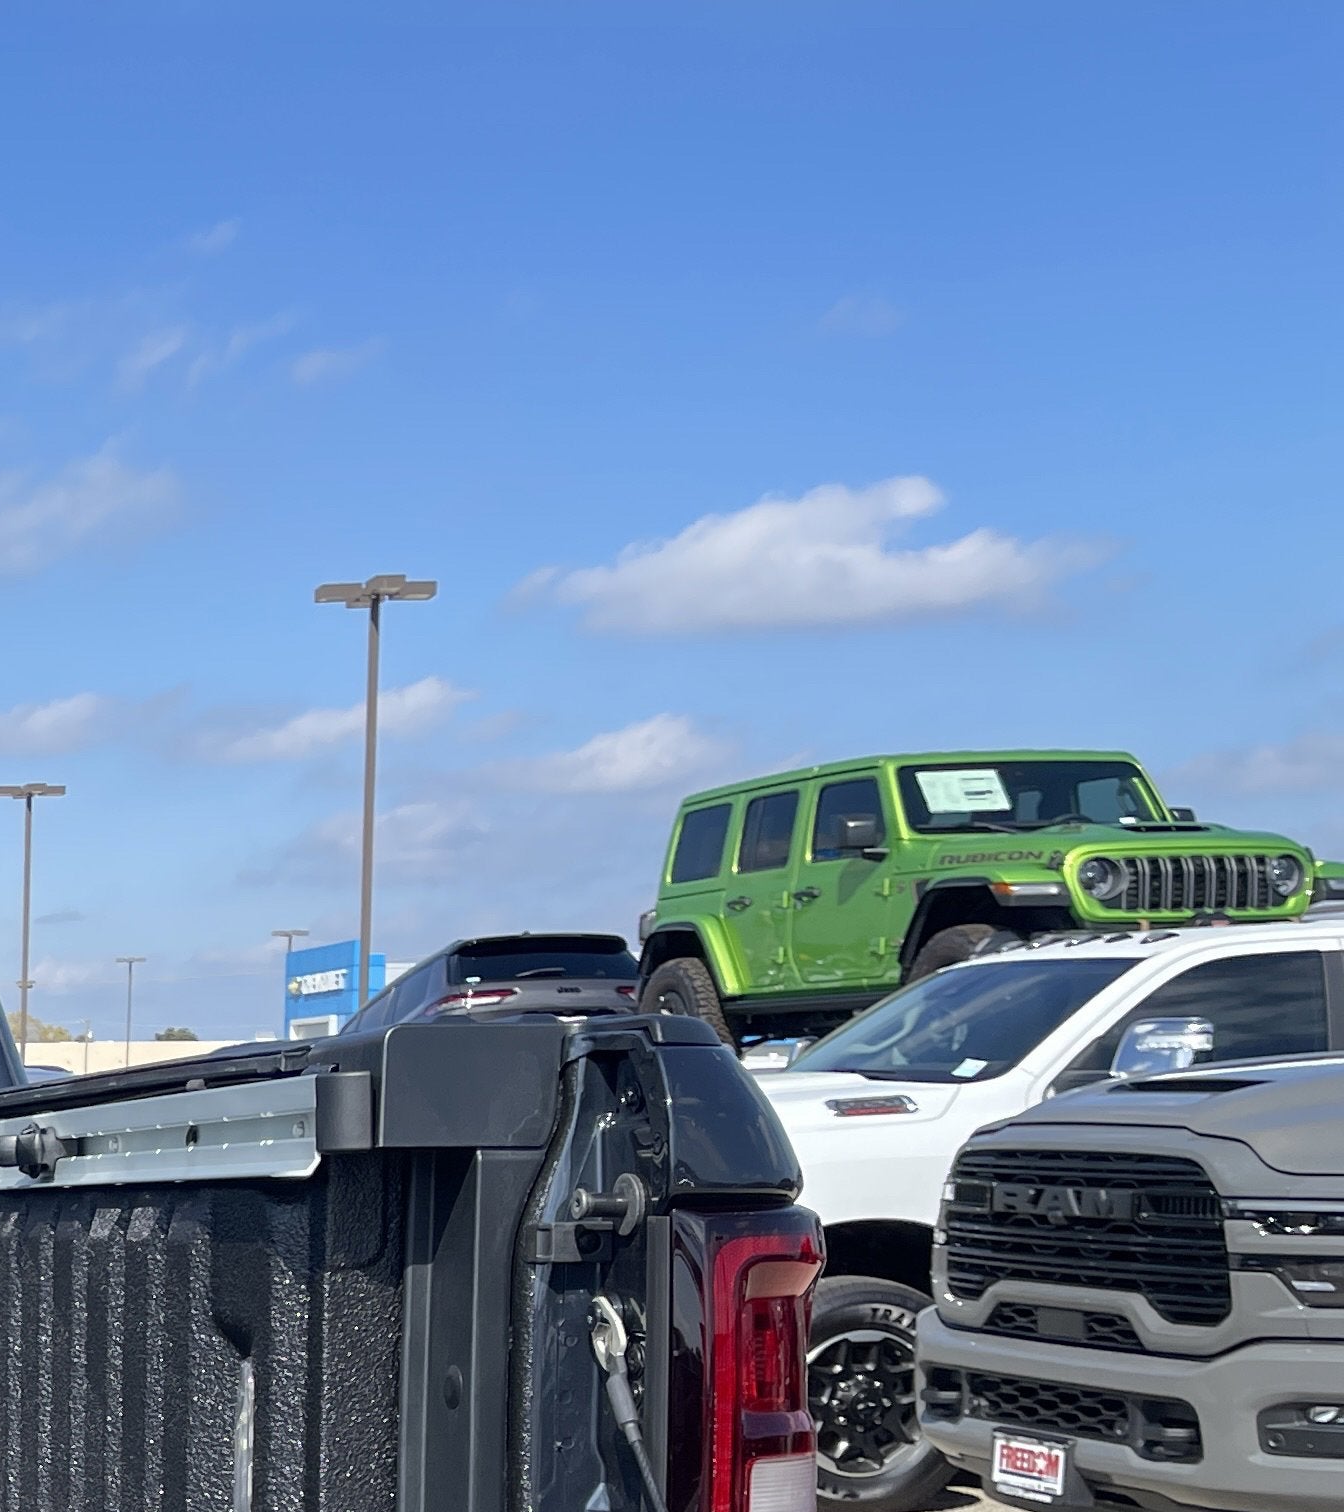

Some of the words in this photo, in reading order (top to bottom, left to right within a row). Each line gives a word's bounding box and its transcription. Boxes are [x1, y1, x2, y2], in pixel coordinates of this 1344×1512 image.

[938, 850, 1044, 866] RUBICON
[993, 1182, 1125, 1221] RAM
[999, 1444, 1060, 1477] FREEDOM
